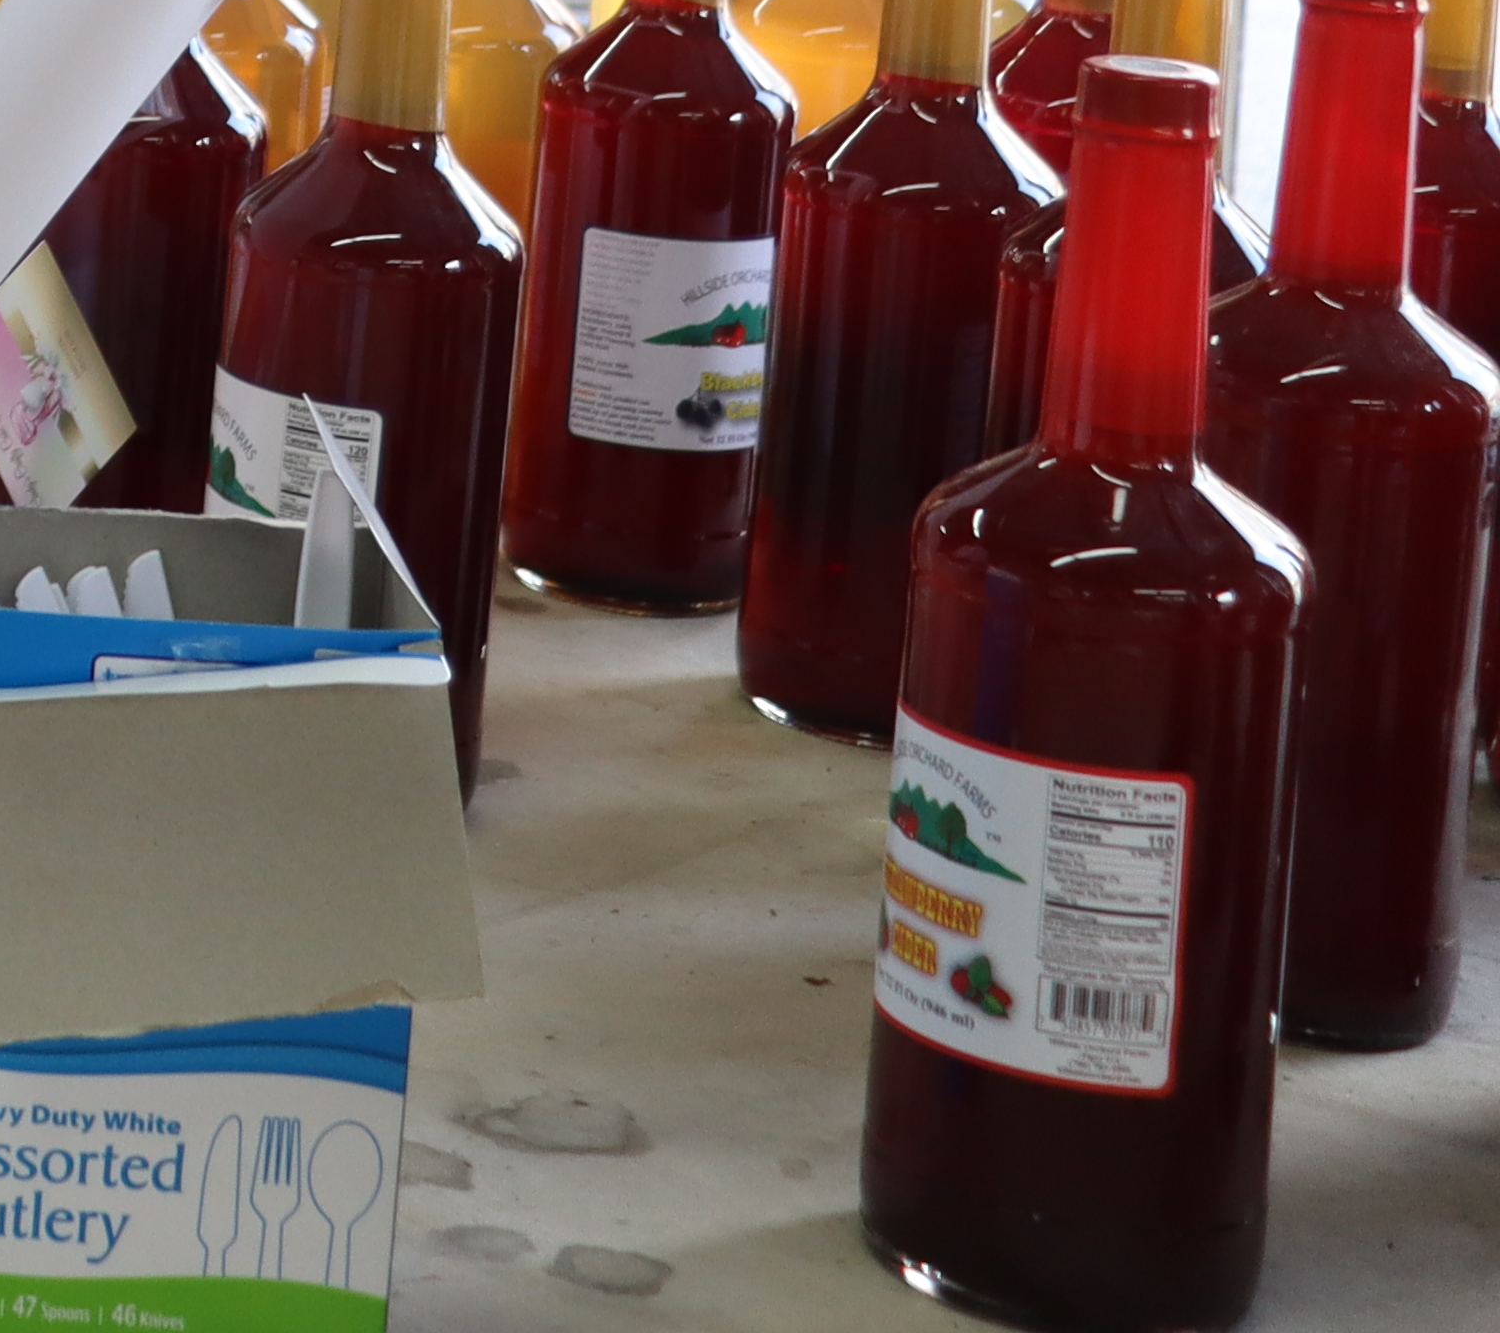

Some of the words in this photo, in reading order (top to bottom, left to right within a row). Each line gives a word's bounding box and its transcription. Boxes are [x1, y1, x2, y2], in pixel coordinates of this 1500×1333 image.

[339, 410, 371, 425] Facts
[229, 419, 259, 462] FARMS
[349, 444, 369, 457] 120
[908, 740, 954, 781] ORCHARD
[953, 771, 998, 821] FARMS
[1052, 777, 1128, 801] Nutrition
[1133, 788, 1177, 804] Facts
[1049, 826, 1102, 842] Calories
[1147, 834, 1175, 850] 110
[31, 1104, 96, 1133] Duty
[103, 1110, 182, 1136] White
[12, 1293, 39, 1319] 47
[41, 1300, 91, 1324] Spoons
[111, 1303, 138, 1326] 46
[139, 1311, 185, 1331] Knives
